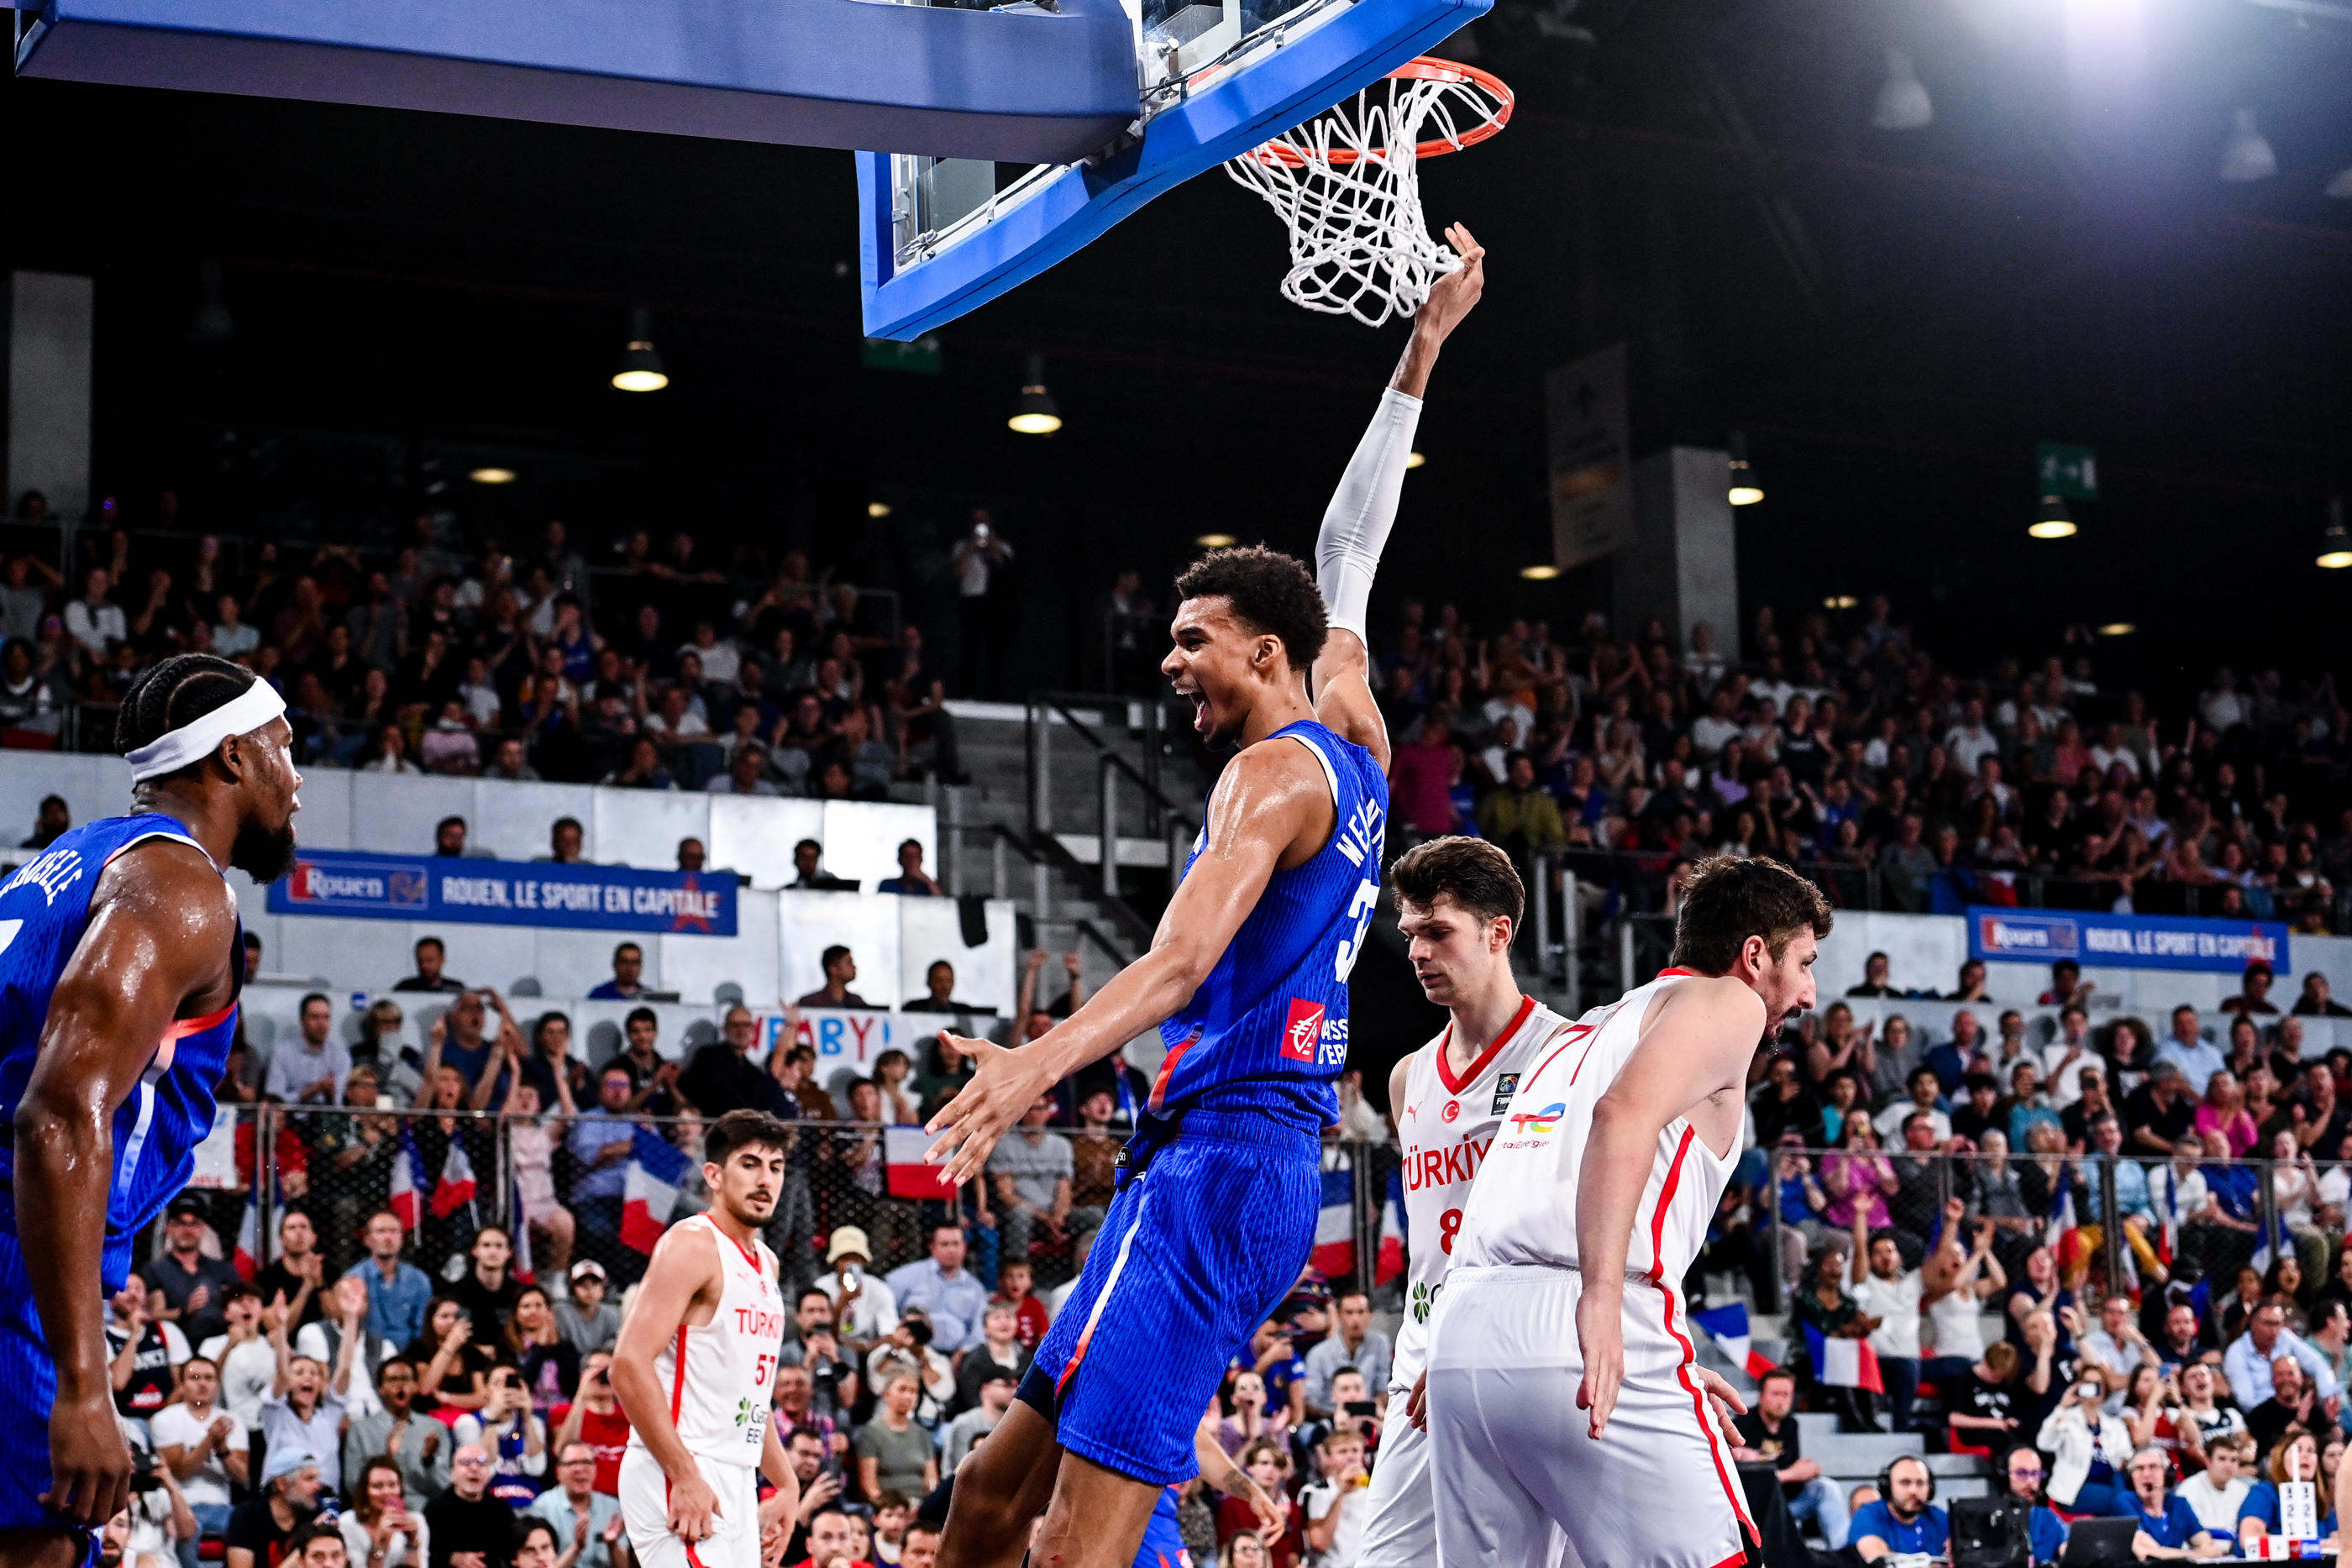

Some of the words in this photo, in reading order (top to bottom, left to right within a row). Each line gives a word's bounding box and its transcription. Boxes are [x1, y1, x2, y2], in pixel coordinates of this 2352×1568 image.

[307, 868, 383, 899] Rouen
[442, 876, 512, 909] ROUEN,
[514, 880, 539, 909] LE
[542, 882, 601, 911] SPORT
[604, 884, 631, 913] EN
[633, 887, 720, 918] CAPITALE
[2135, 930, 2153, 955] LE
[2155, 931, 2197, 957] SPORT
[2197, 933, 2218, 957] EN
[1440, 1208, 1463, 1256] 8
[755, 1354, 775, 1387] 57
